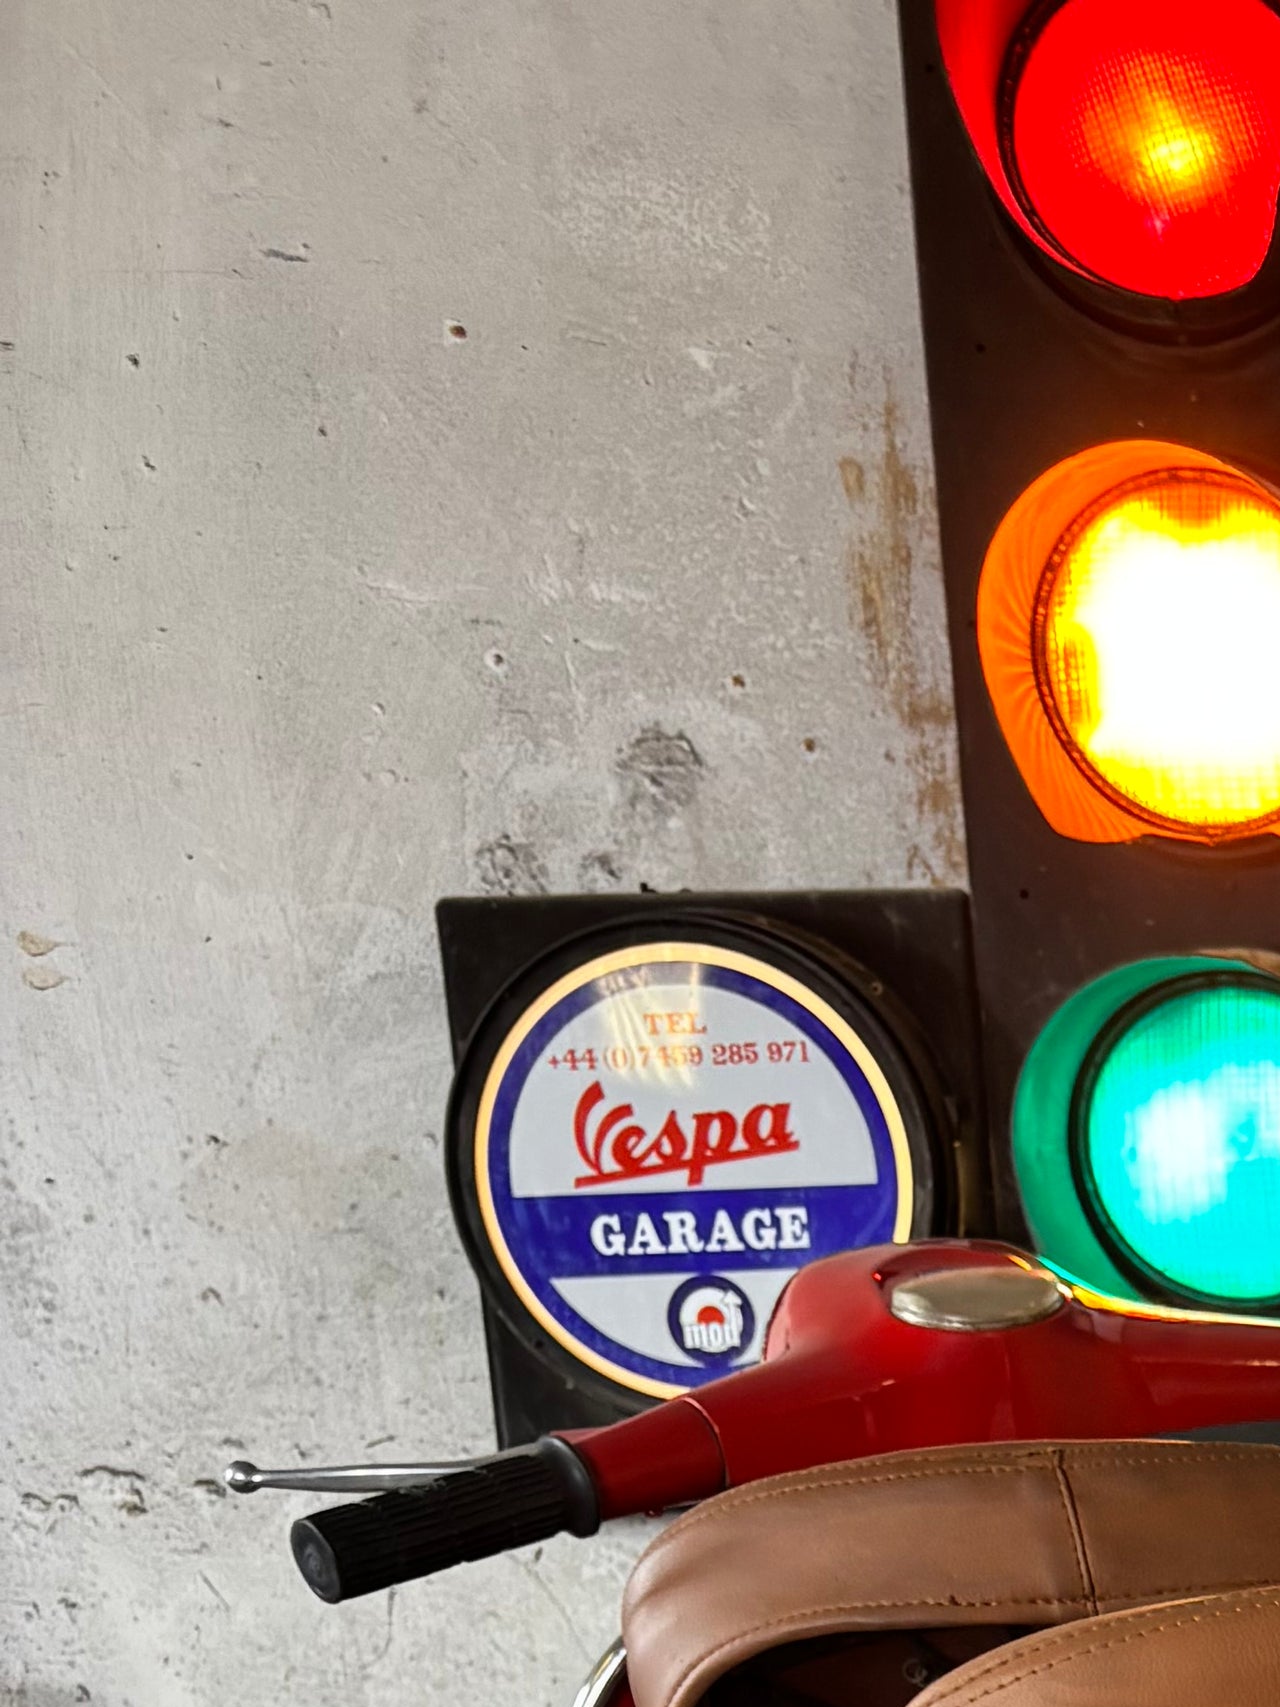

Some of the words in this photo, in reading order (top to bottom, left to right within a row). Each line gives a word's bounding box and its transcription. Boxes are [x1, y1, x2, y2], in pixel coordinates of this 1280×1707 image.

[643, 1012, 707, 1036] TEL
[548, 1047, 598, 1071] +44
[712, 1042, 759, 1066] 285
[767, 1040, 810, 1063] 971
[574, 1081, 799, 1189] Vespa
[590, 1206, 811, 1257] GARAGE
